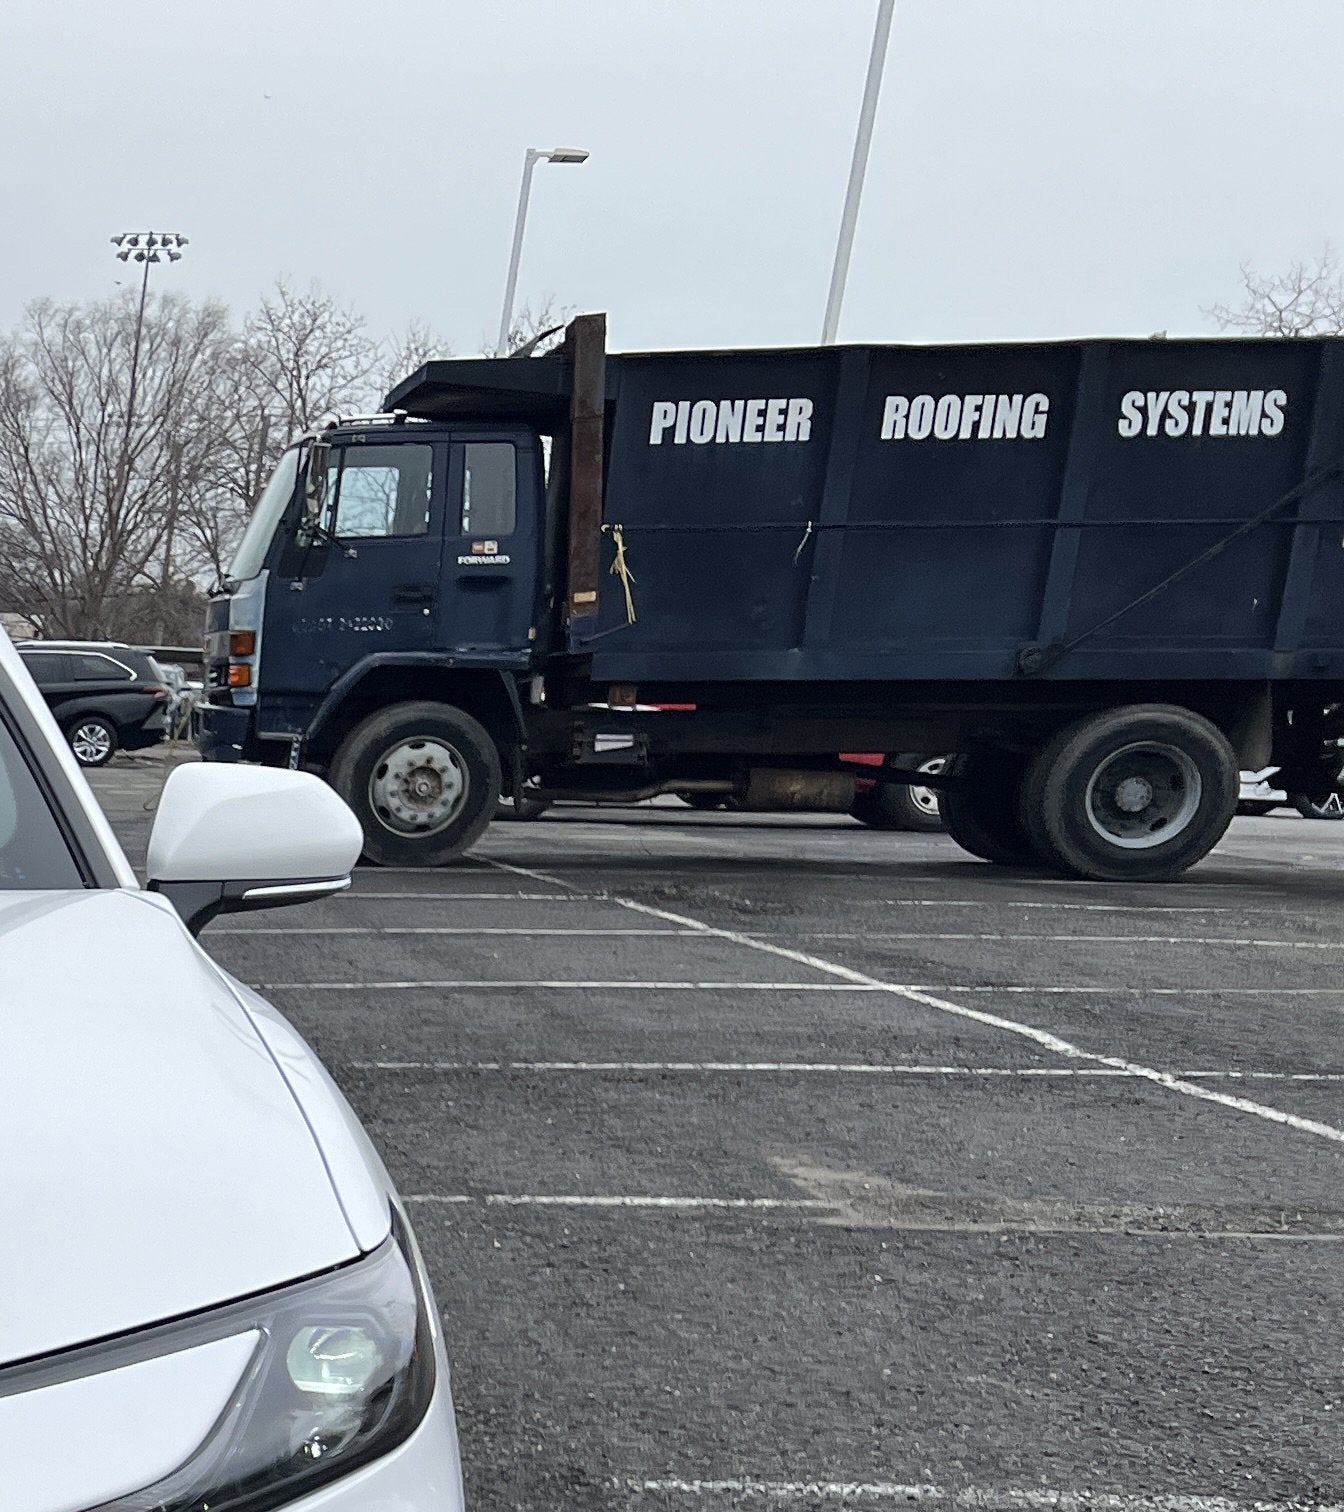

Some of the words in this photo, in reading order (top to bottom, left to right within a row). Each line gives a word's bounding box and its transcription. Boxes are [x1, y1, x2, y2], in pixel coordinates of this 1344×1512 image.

[648, 397, 814, 445] PIONEER
[879, 393, 1050, 440] ROOFING
[1116, 388, 1288, 438] SYSTEMS
